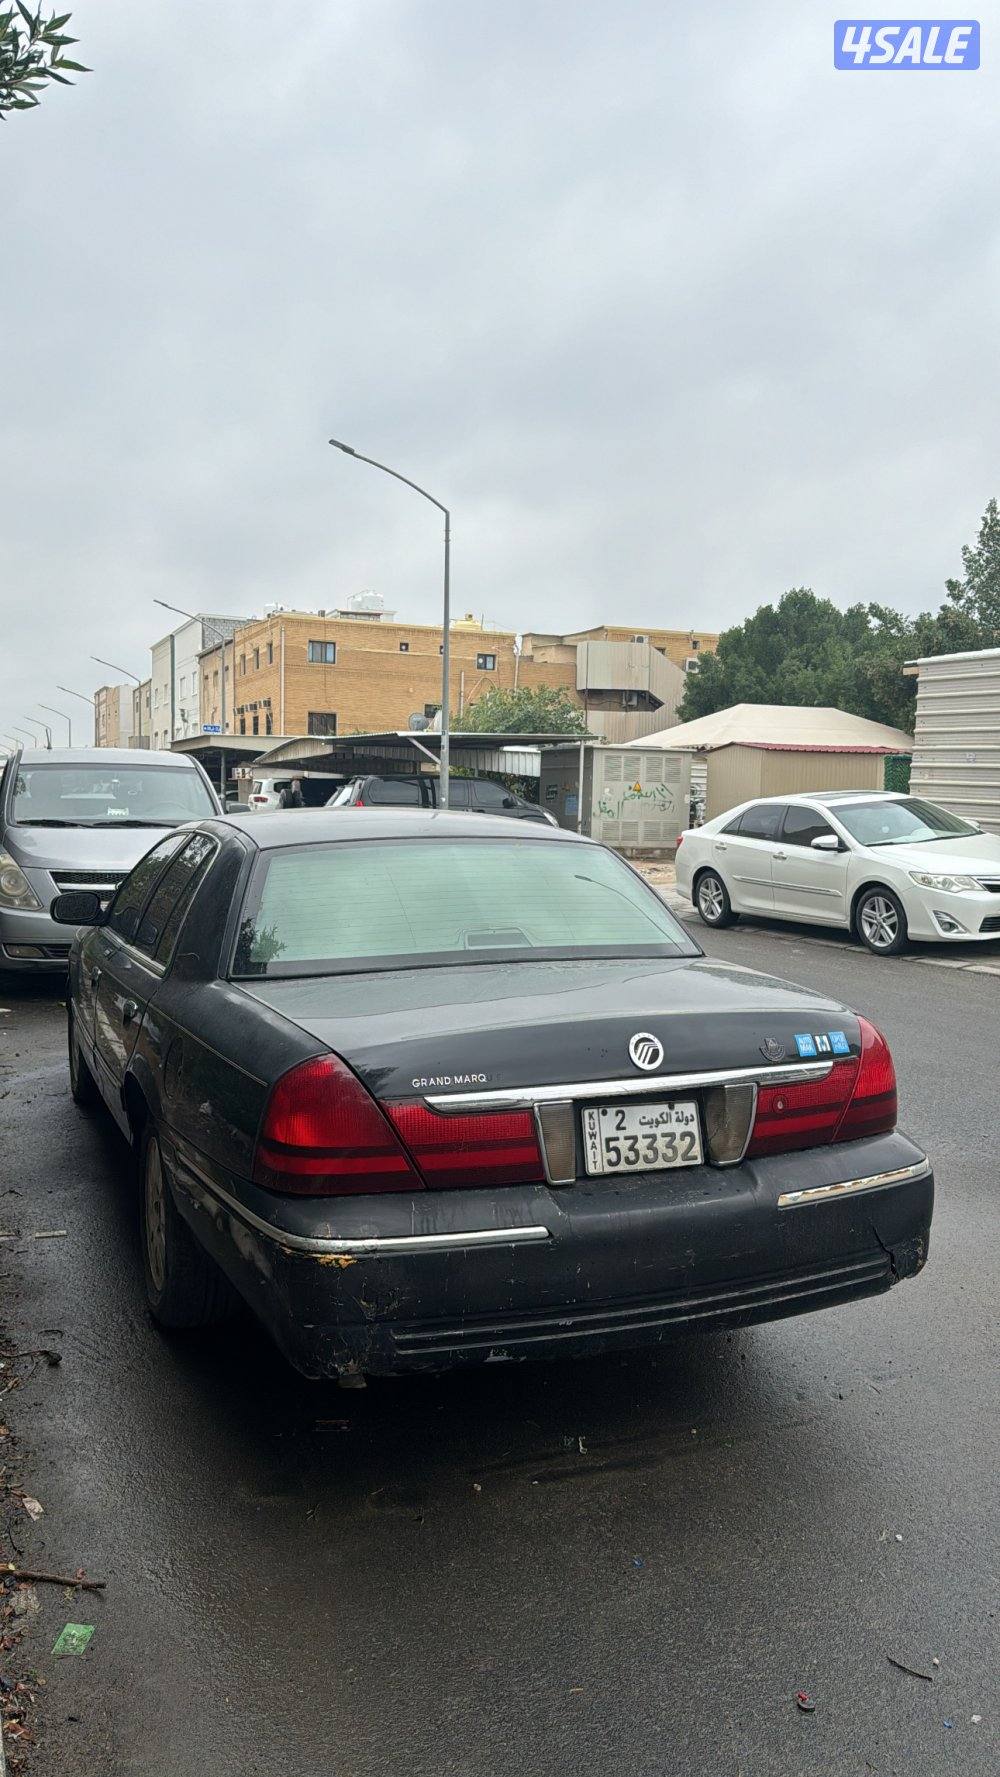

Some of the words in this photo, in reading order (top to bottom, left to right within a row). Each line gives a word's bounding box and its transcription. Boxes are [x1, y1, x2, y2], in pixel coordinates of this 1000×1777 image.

[412, 1076, 451, 1088] GRAND
[615, 1109, 627, 1131] 2
[639, 1111, 672, 1128] الكويت
[675, 1110, 695, 1126] دولة
[588, 1111, 599, 1170] KUWAIT
[604, 1130, 698, 1167] 53332
